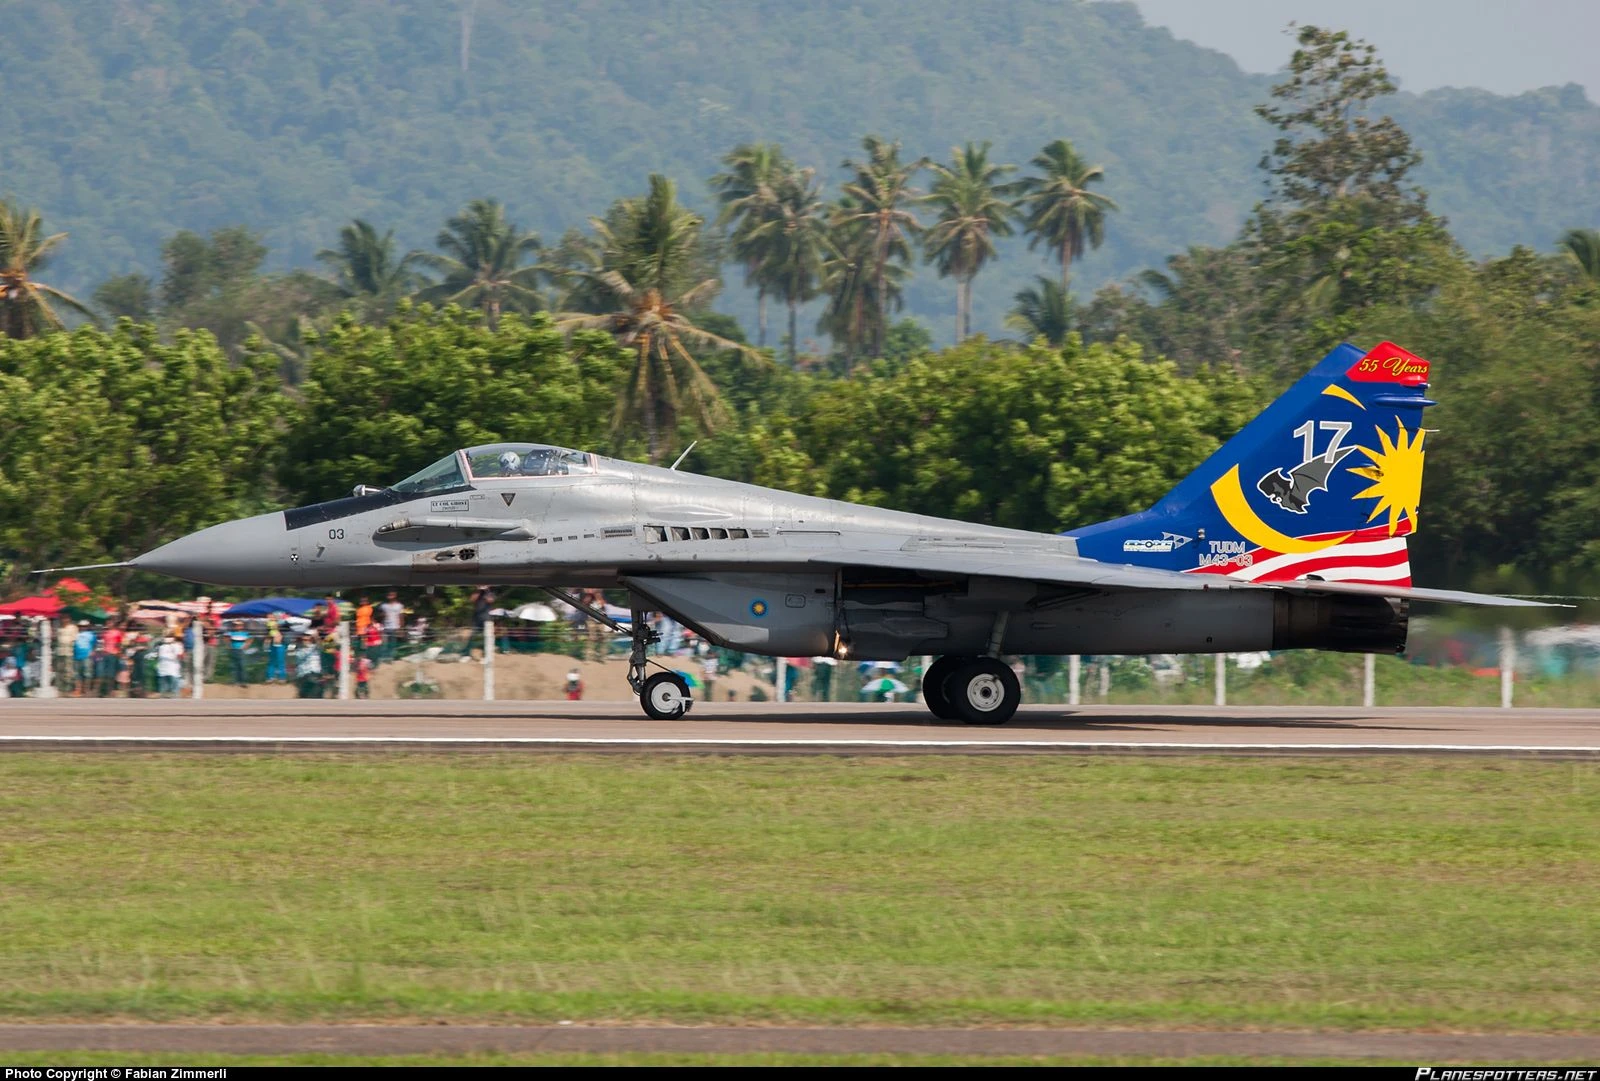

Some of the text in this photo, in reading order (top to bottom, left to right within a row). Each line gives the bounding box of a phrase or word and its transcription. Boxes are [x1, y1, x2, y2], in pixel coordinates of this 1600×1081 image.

[1359, 356, 1427, 377] 55 Years
[1293, 420, 1352, 463] 17
[328, 528, 345, 540] 03
[1208, 540, 1246, 554] TUDM
[1198, 553, 1253, 567] M43-03
